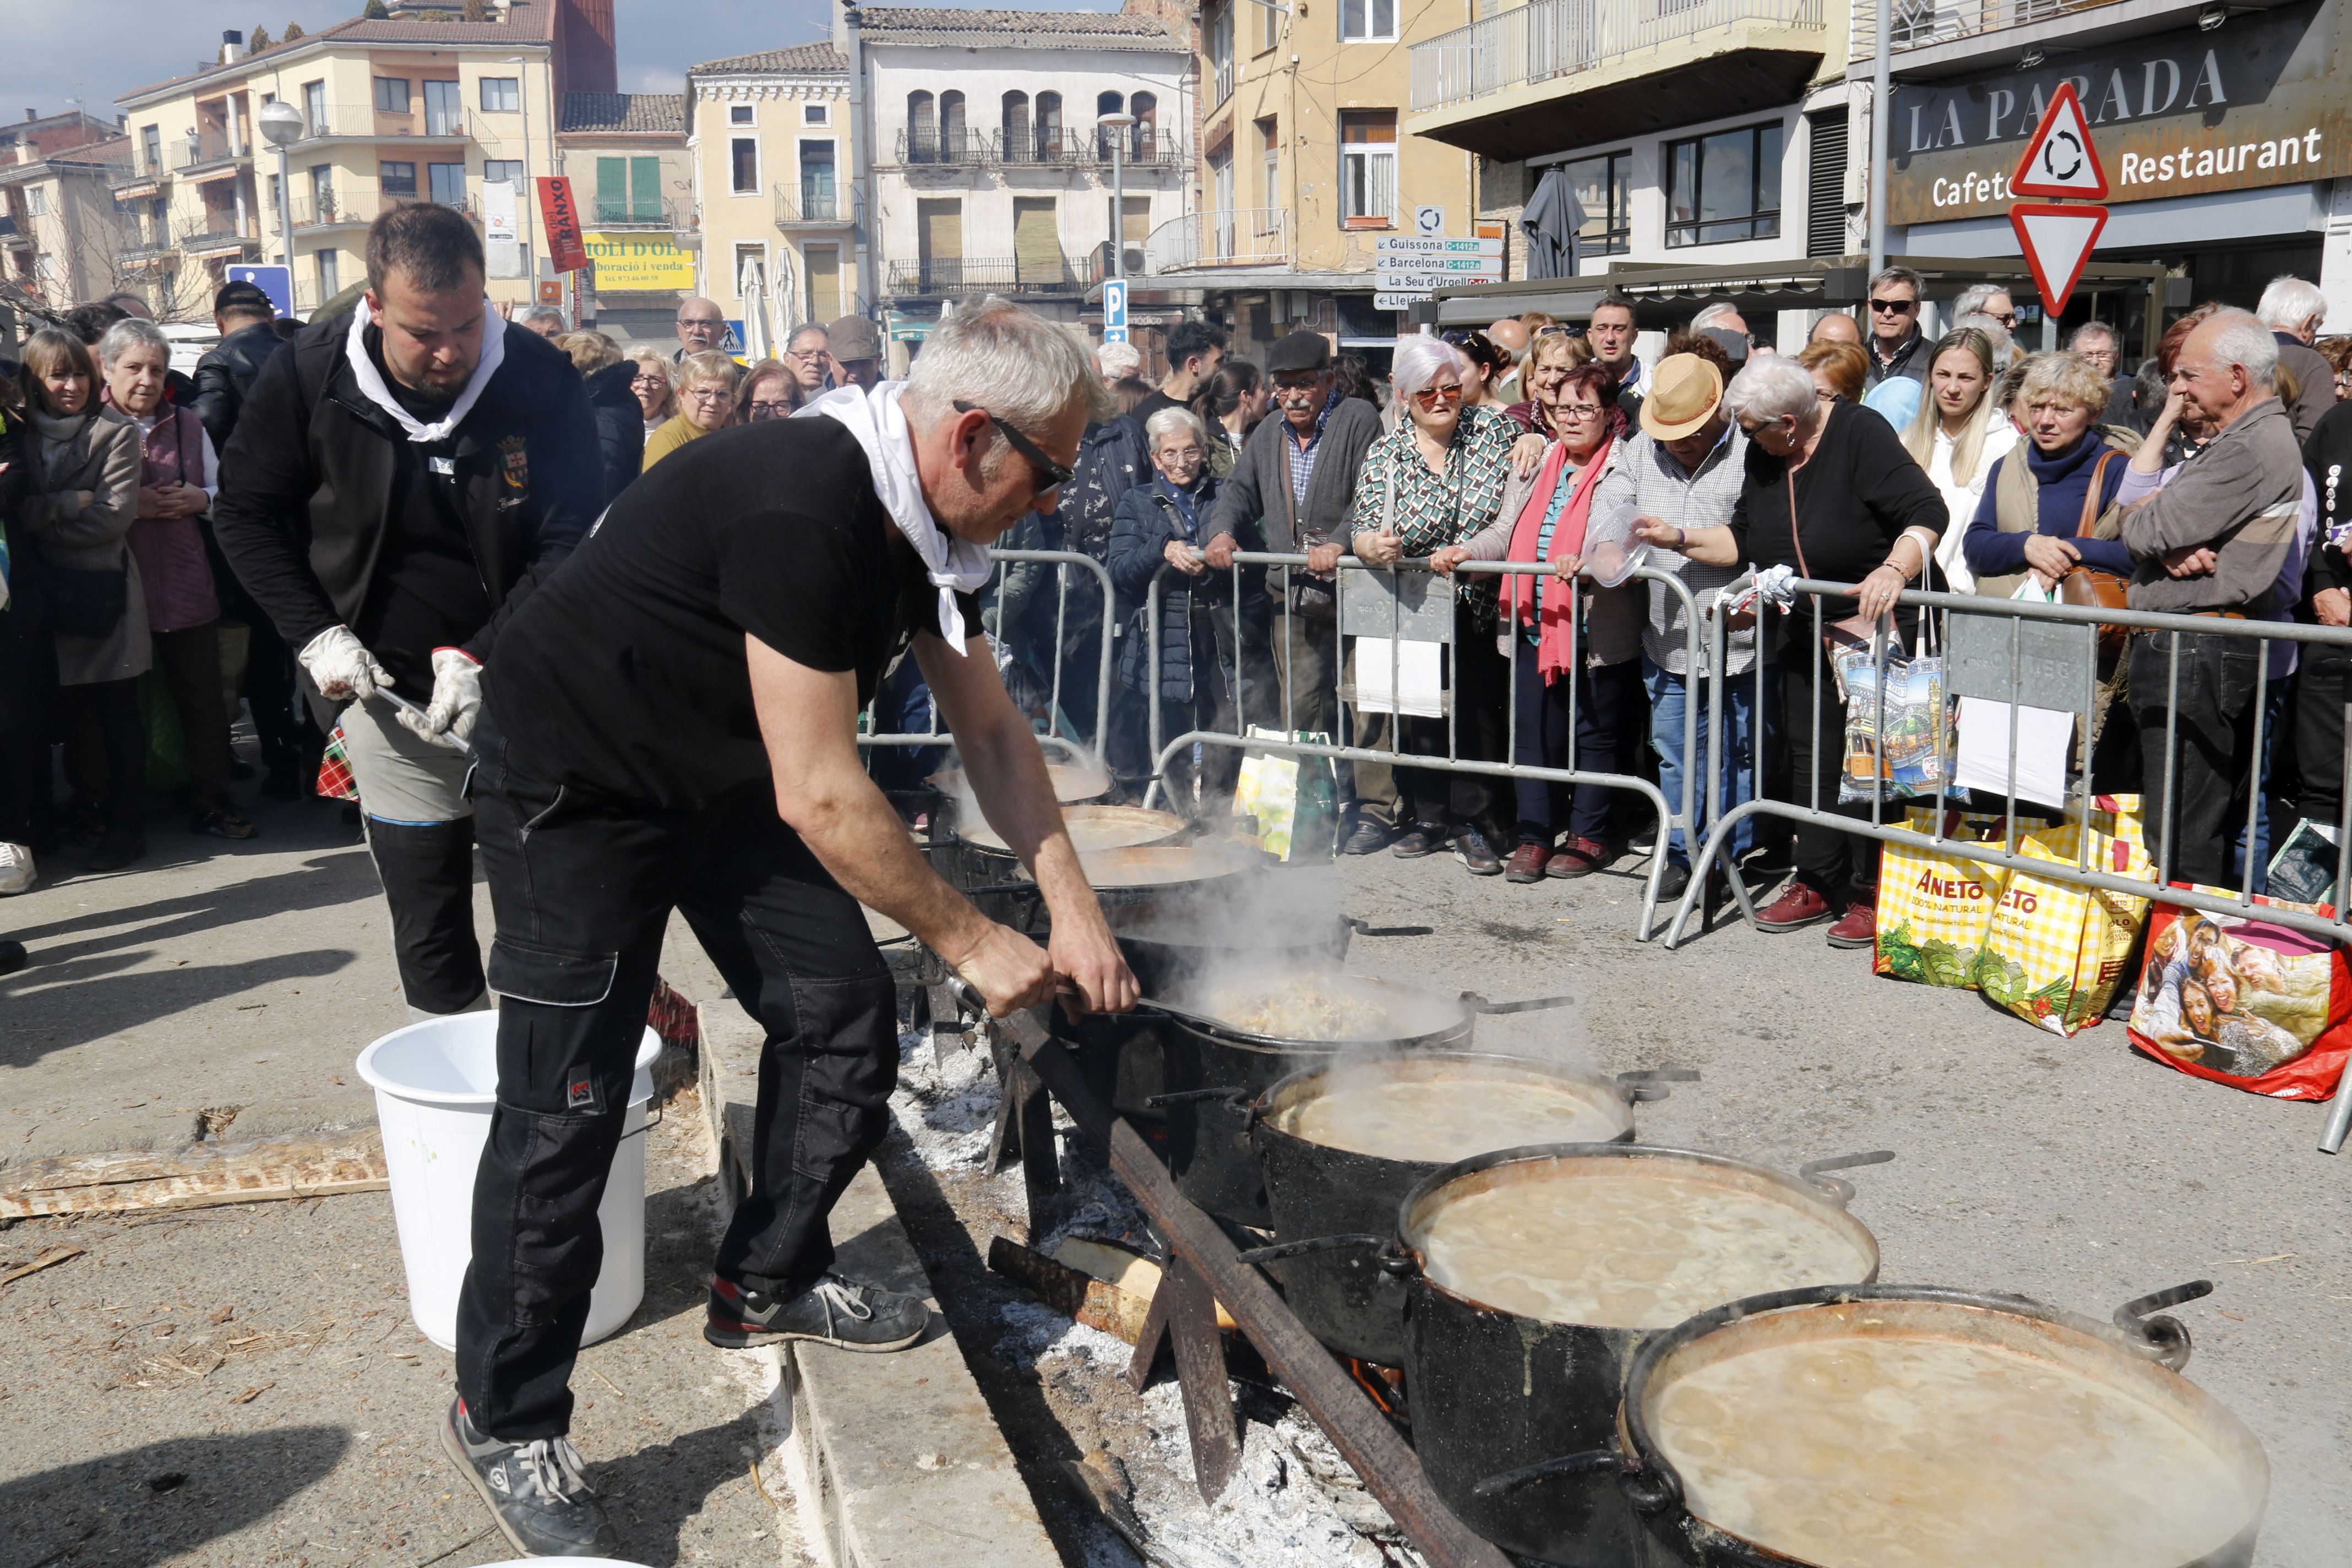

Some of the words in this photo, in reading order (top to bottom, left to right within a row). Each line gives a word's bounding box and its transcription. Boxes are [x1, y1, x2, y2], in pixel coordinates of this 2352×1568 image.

[1907, 99, 1965, 153] LA
[2121, 127, 2322, 186] Restaurant
[551, 179, 573, 239] RANXO
[546, 211, 558, 229] del
[1390, 238, 1442, 249] Guissona
[1445, 241, 1479, 251] C-1412a
[643, 262, 646, 271] i
[650, 260, 683, 271] venda
[1390, 257, 1444, 268] Barcelona
[1447, 260, 1480, 269] C-1412a
[1389, 276, 1401, 286] La
[1405, 276, 1424, 286] Seu
[1427, 275, 1466, 287] d'Urgell
[1107, 286, 1121, 324] P
[1390, 295, 1424, 306] Lleida
[1915, 868, 1984, 900] ANETO
[1911, 896, 1931, 910] 100%
[1934, 903, 1983, 914] NATURAL
[1992, 912, 2030, 930] ATURAL
